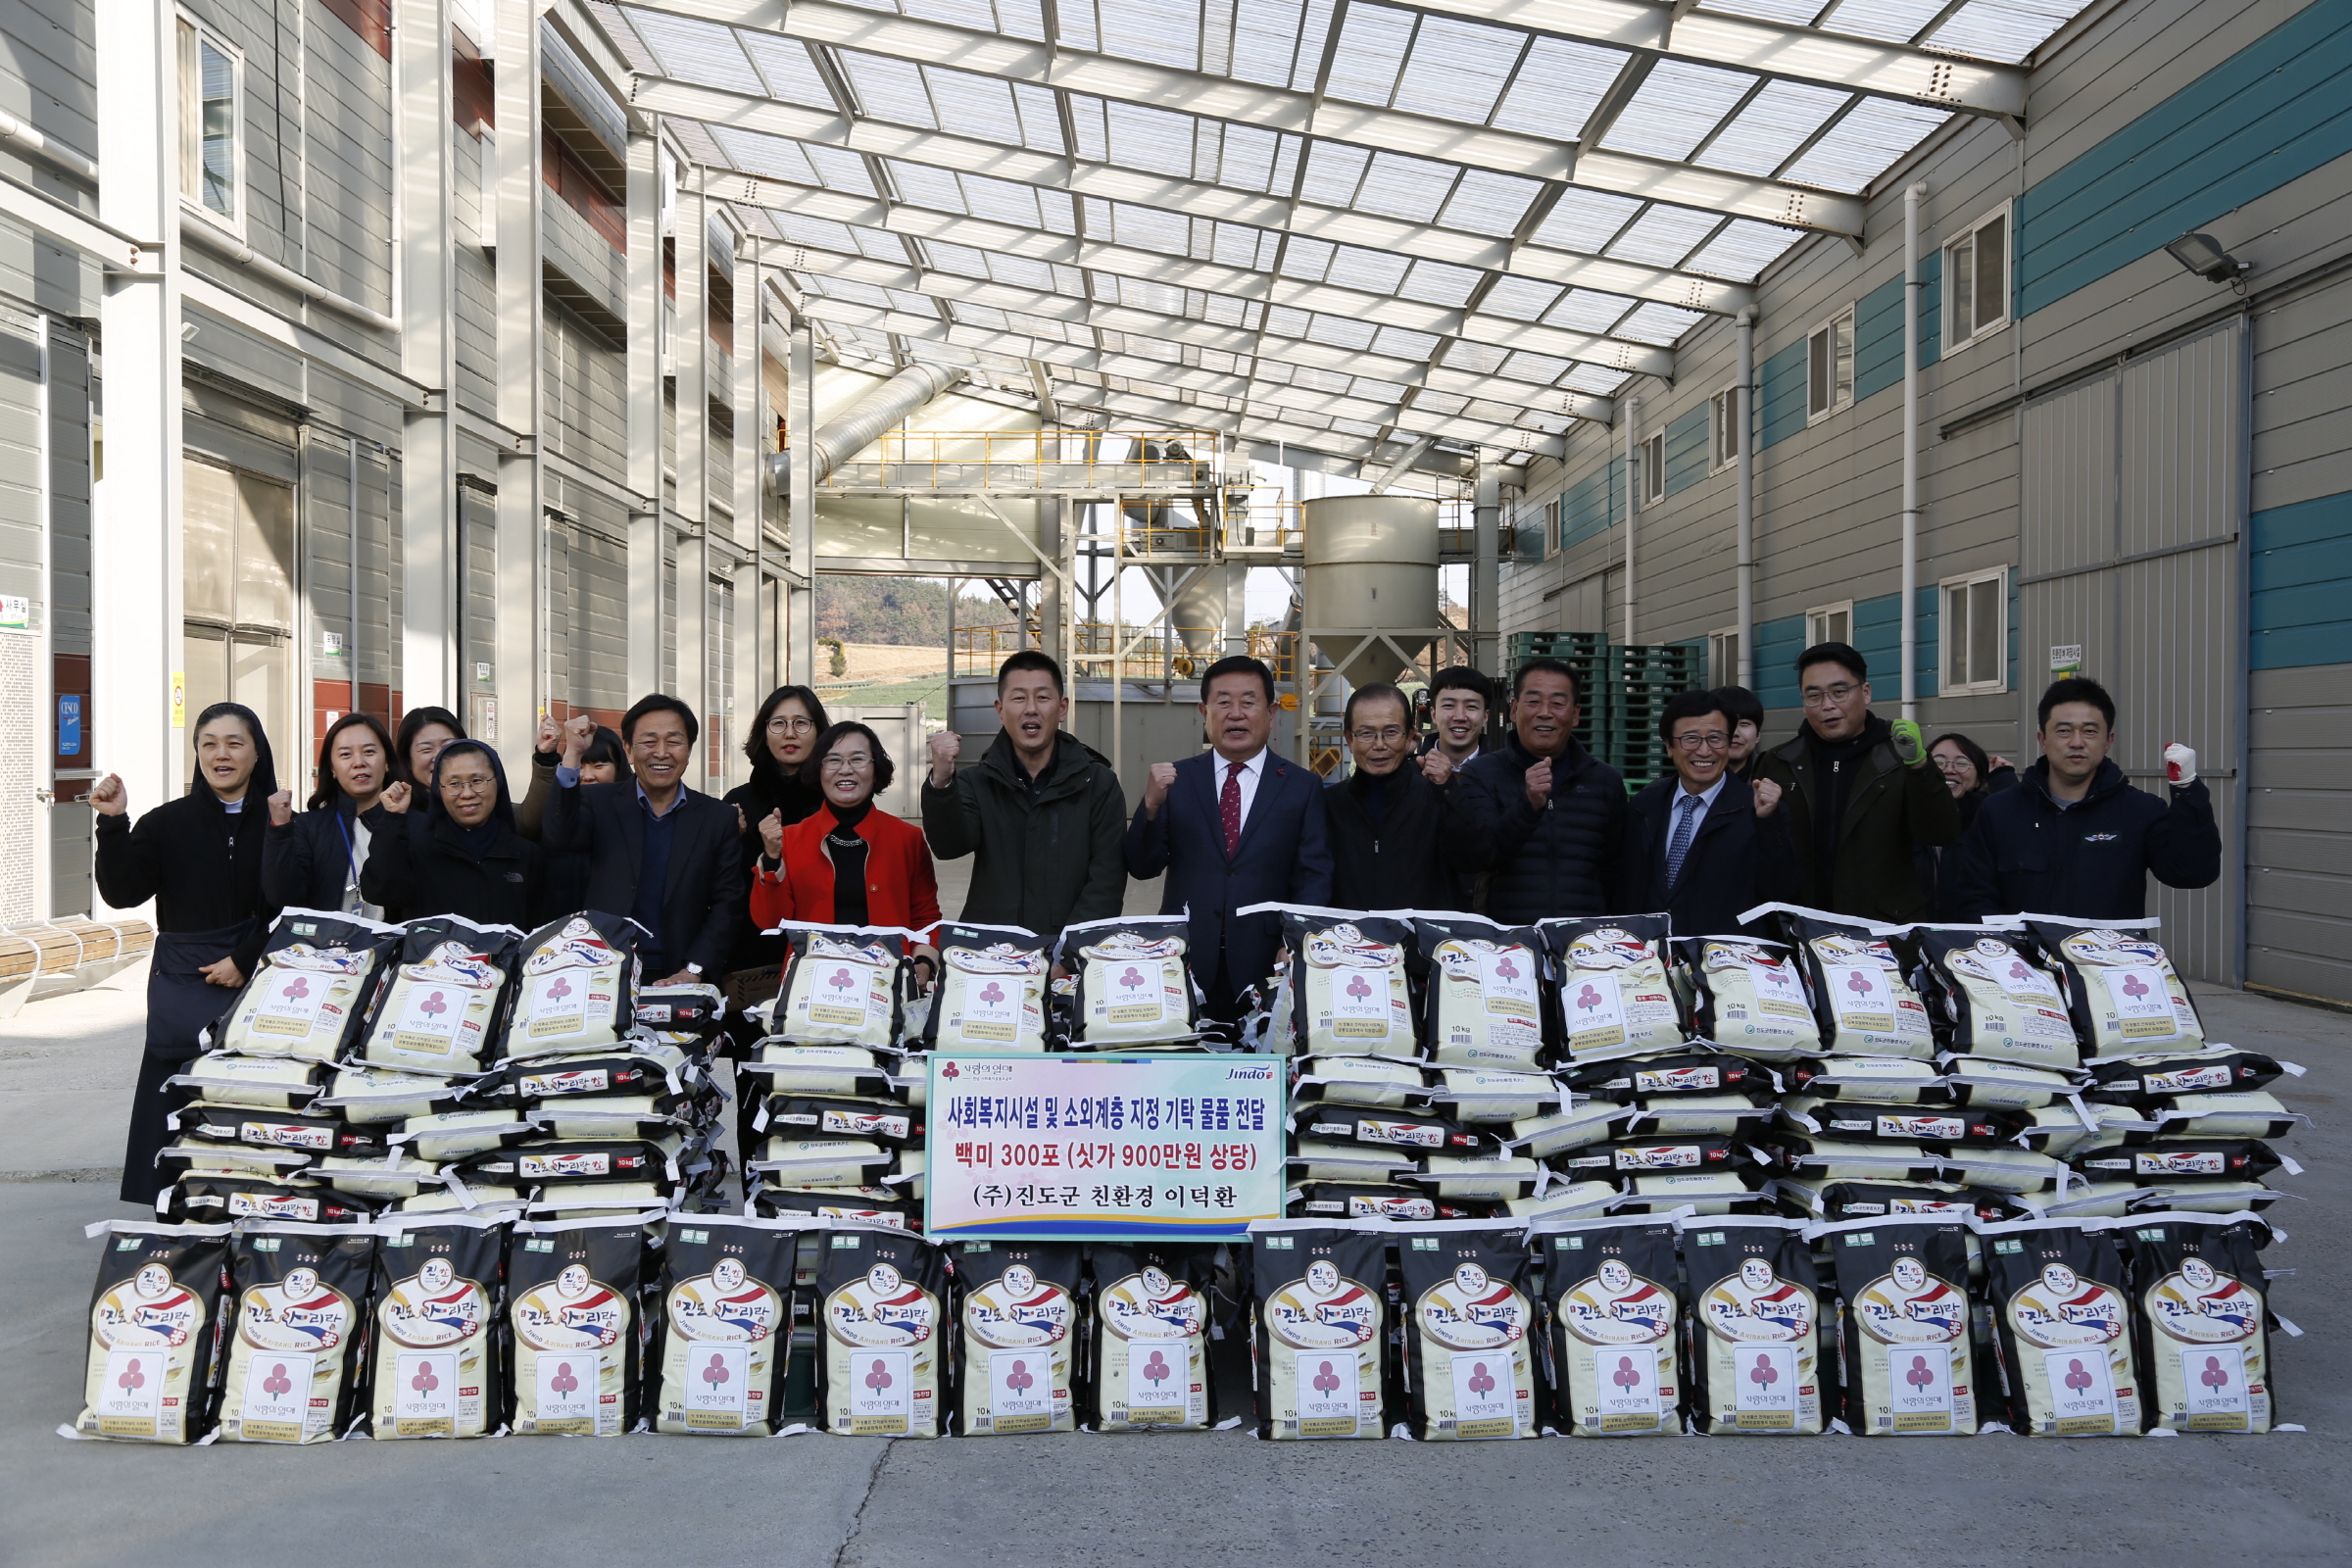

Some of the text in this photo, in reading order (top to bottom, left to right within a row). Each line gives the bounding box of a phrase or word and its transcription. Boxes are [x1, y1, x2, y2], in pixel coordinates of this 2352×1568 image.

[6, 599, 26, 612] 사무실
[61, 702, 78, 714] CESCO
[1225, 1068, 1265, 1080] Jindo
[948, 1096, 1265, 1130] 사회복지시설 및 소외계층 지정 기탁 물품 전달
[956, 1142, 1257, 1171] 백미 300포 (싯가 900만원 상당)
[974, 1184, 1237, 1208] (주)진도군 친환경 이덕환
[1927, 1333, 1942, 1341] RICE
[2084, 1334, 2100, 1343] RICE
